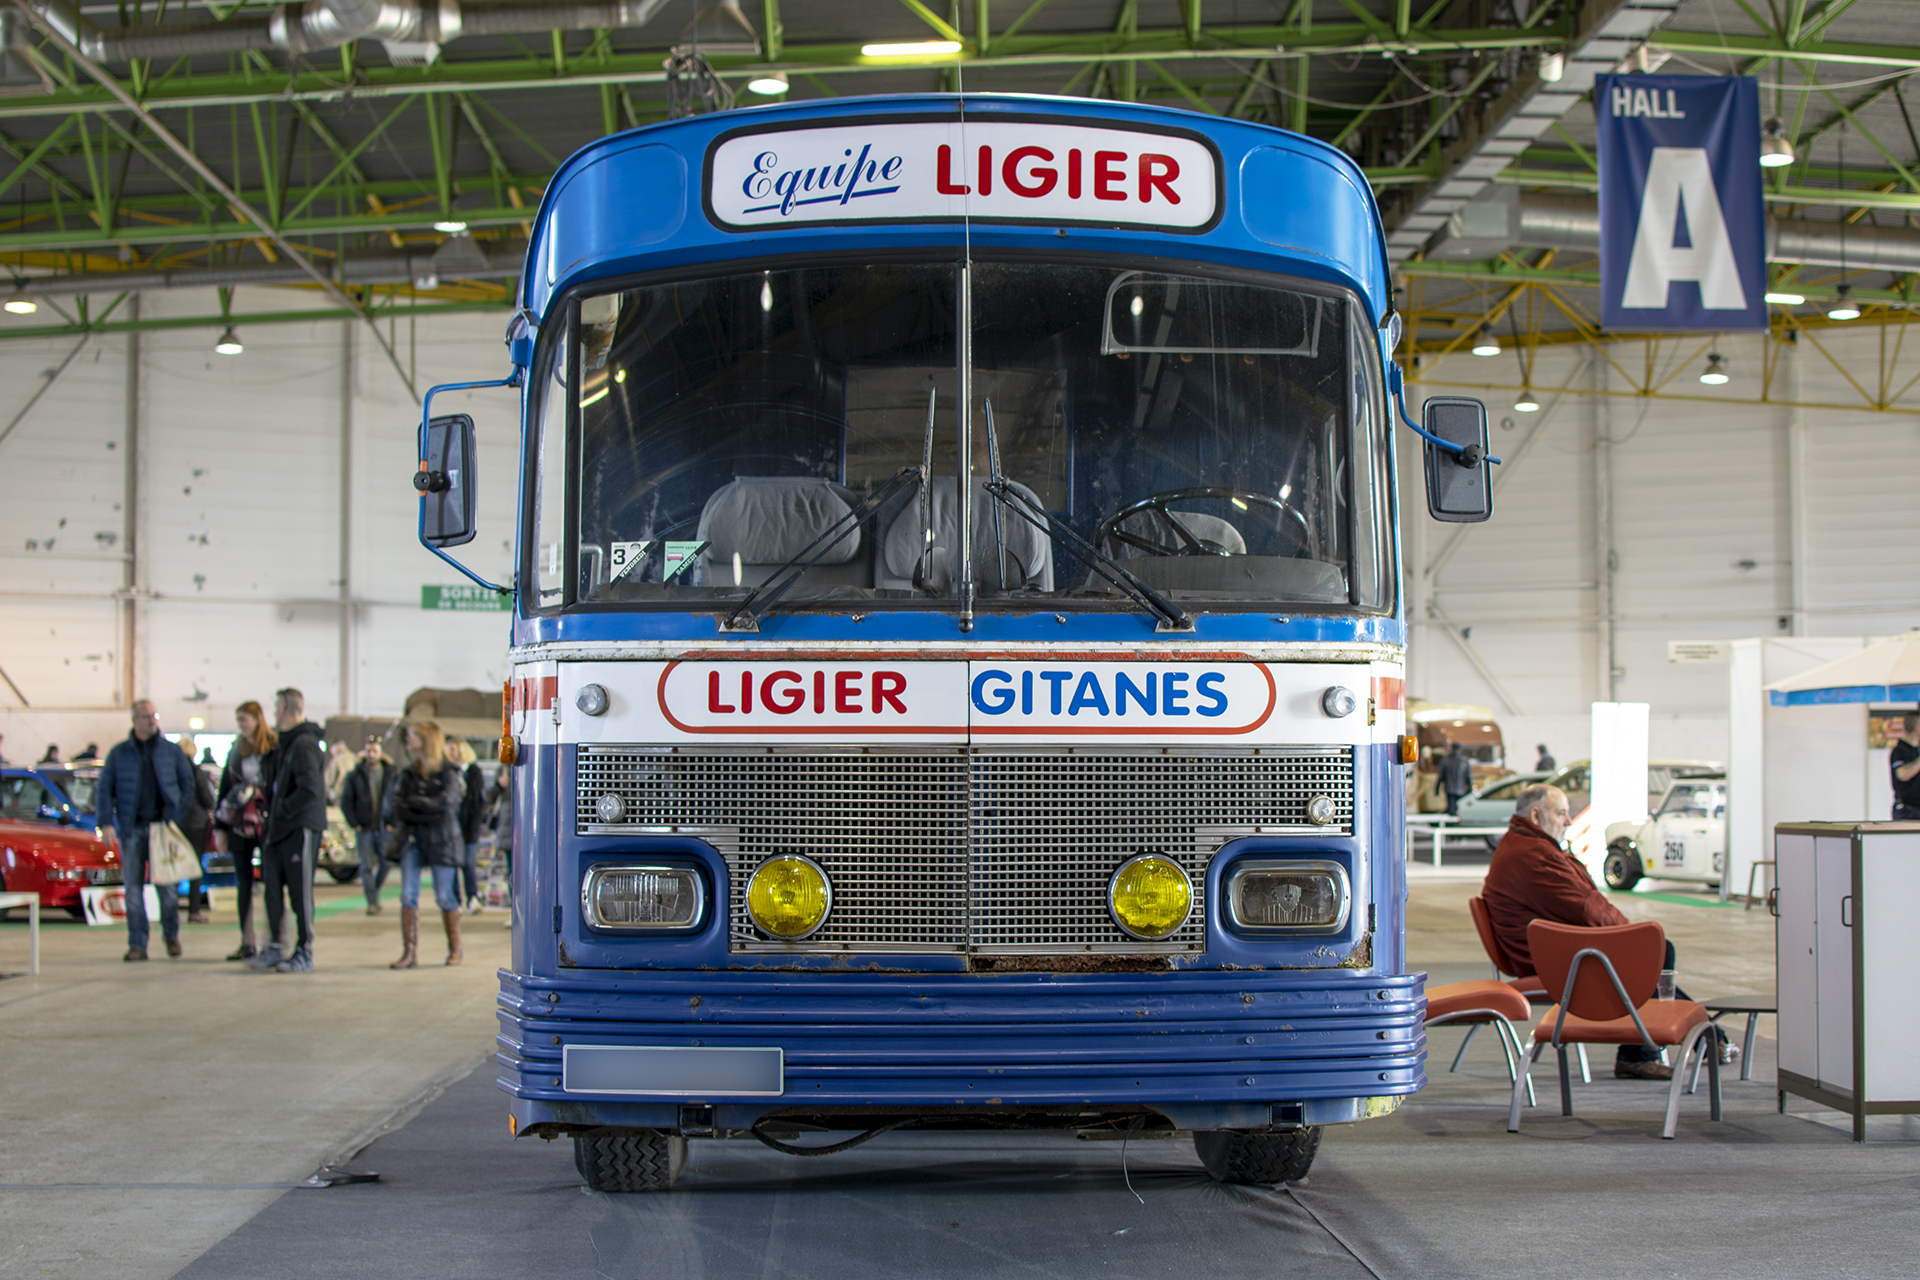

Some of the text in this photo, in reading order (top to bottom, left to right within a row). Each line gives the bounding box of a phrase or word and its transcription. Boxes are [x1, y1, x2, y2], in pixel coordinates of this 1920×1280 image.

[1612, 87, 1686, 119] HALL
[742, 143, 1182, 216] Equipe LIGIER
[1622, 147, 1747, 310] A
[613, 548, 626, 565] 3
[619, 550, 647, 578] VENDREDI
[675, 553, 698, 576] SAMEDI
[440, 587, 499, 600] SORTIE
[708, 670, 1229, 718] LIGIER GITANES
[1664, 841, 1685, 861] 260
